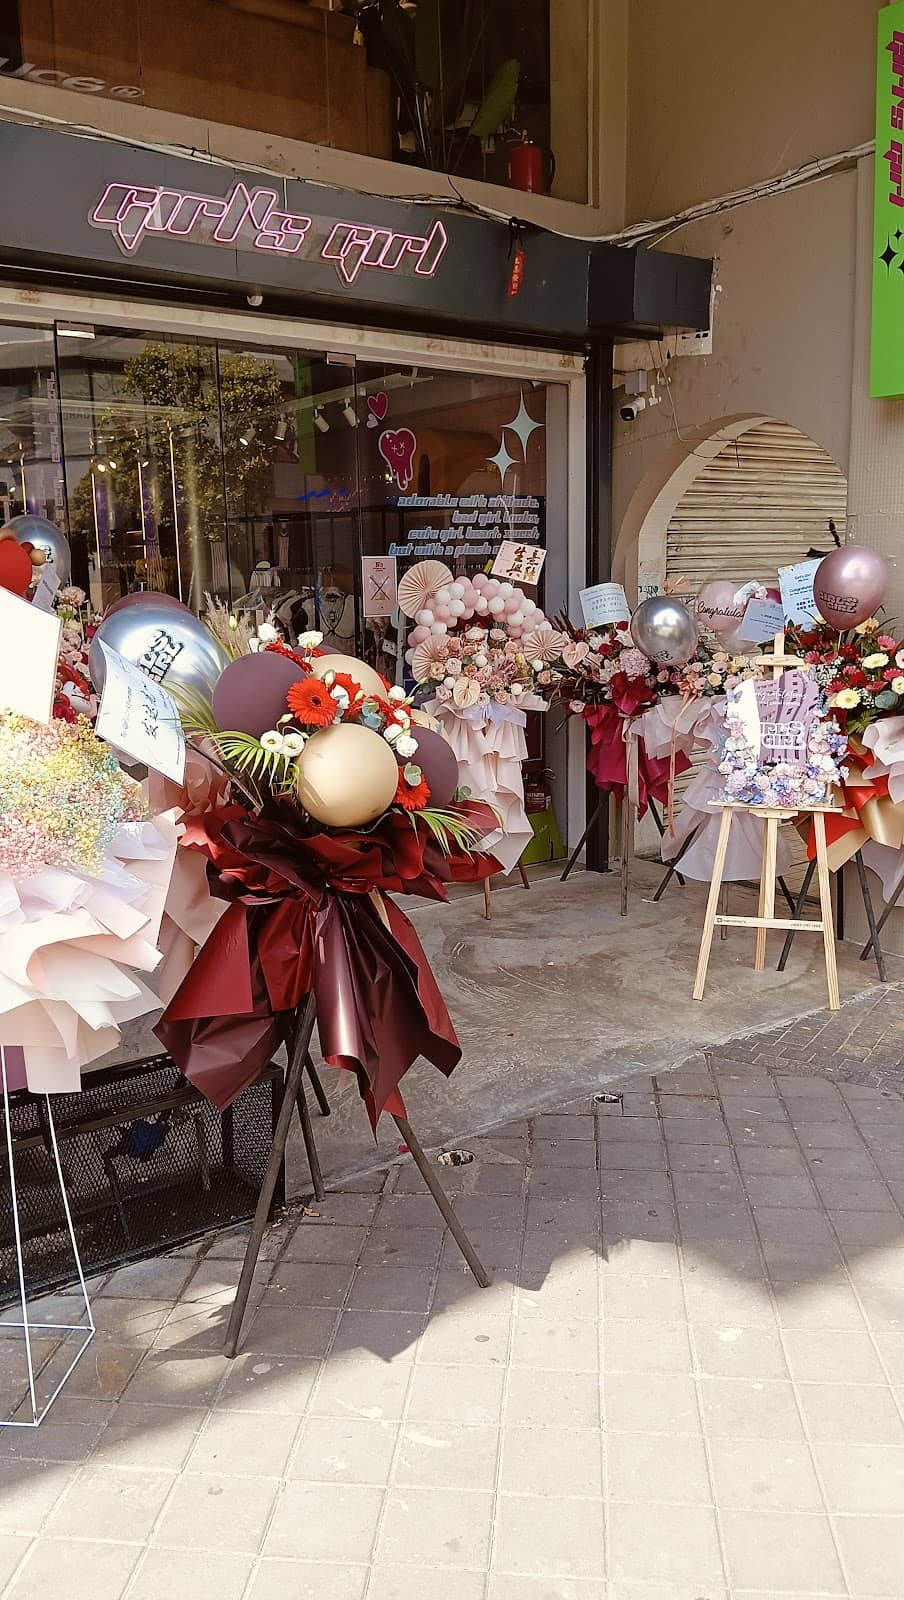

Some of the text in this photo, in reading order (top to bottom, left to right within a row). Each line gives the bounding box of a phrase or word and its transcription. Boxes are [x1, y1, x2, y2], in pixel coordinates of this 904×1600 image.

[397, 493, 458, 507] adorable
[458, 495, 487, 507] with
[478, 511, 502, 526] girl
[440, 526, 464, 542] girl
[388, 543, 413, 556] but
[414, 543, 444, 555] with
